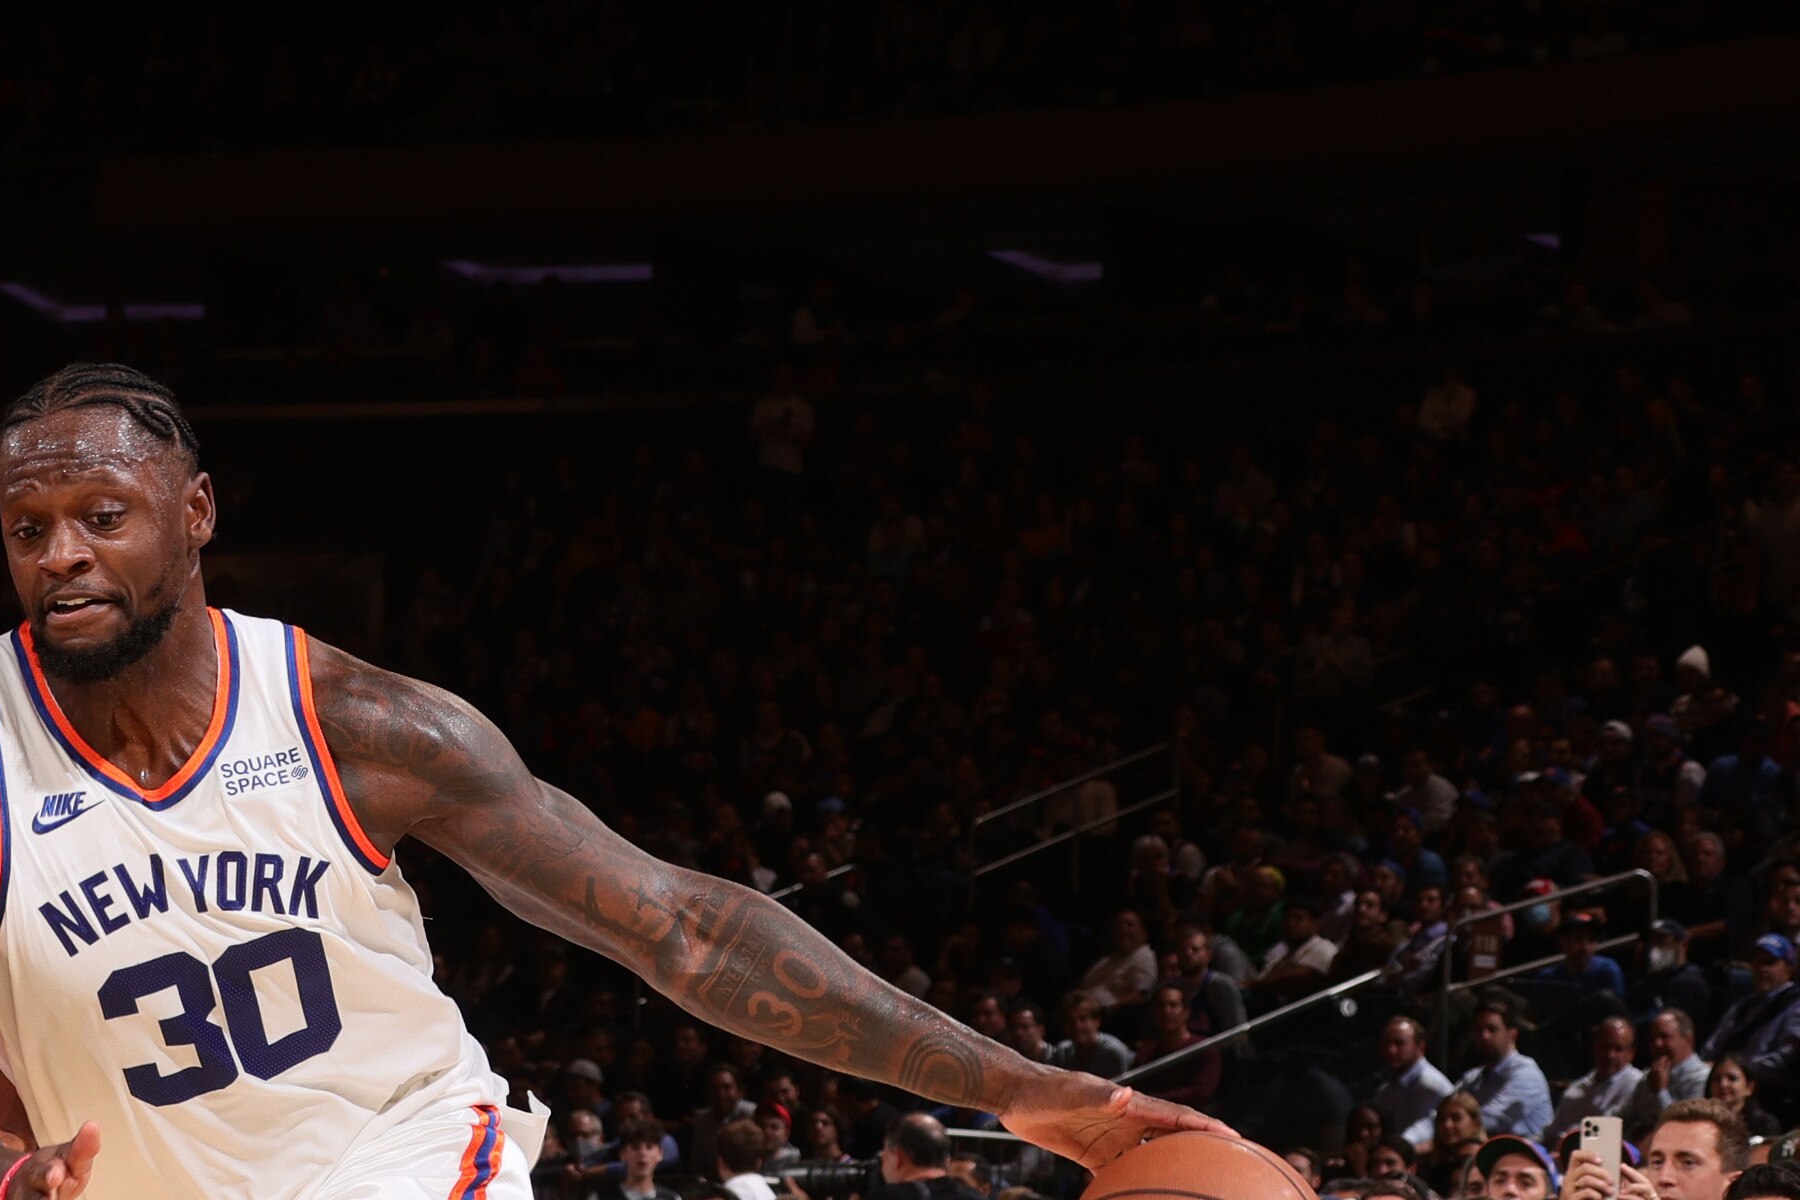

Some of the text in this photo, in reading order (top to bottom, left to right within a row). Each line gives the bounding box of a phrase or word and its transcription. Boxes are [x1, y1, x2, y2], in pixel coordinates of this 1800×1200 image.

[221, 747, 302, 778] SQUARE
[225, 769, 290, 796] SPACE
[40, 791, 87, 819] NIKE
[38, 850, 331, 957] NEW YORK
[97, 926, 343, 1108] 30
[747, 950, 829, 1037] 30
